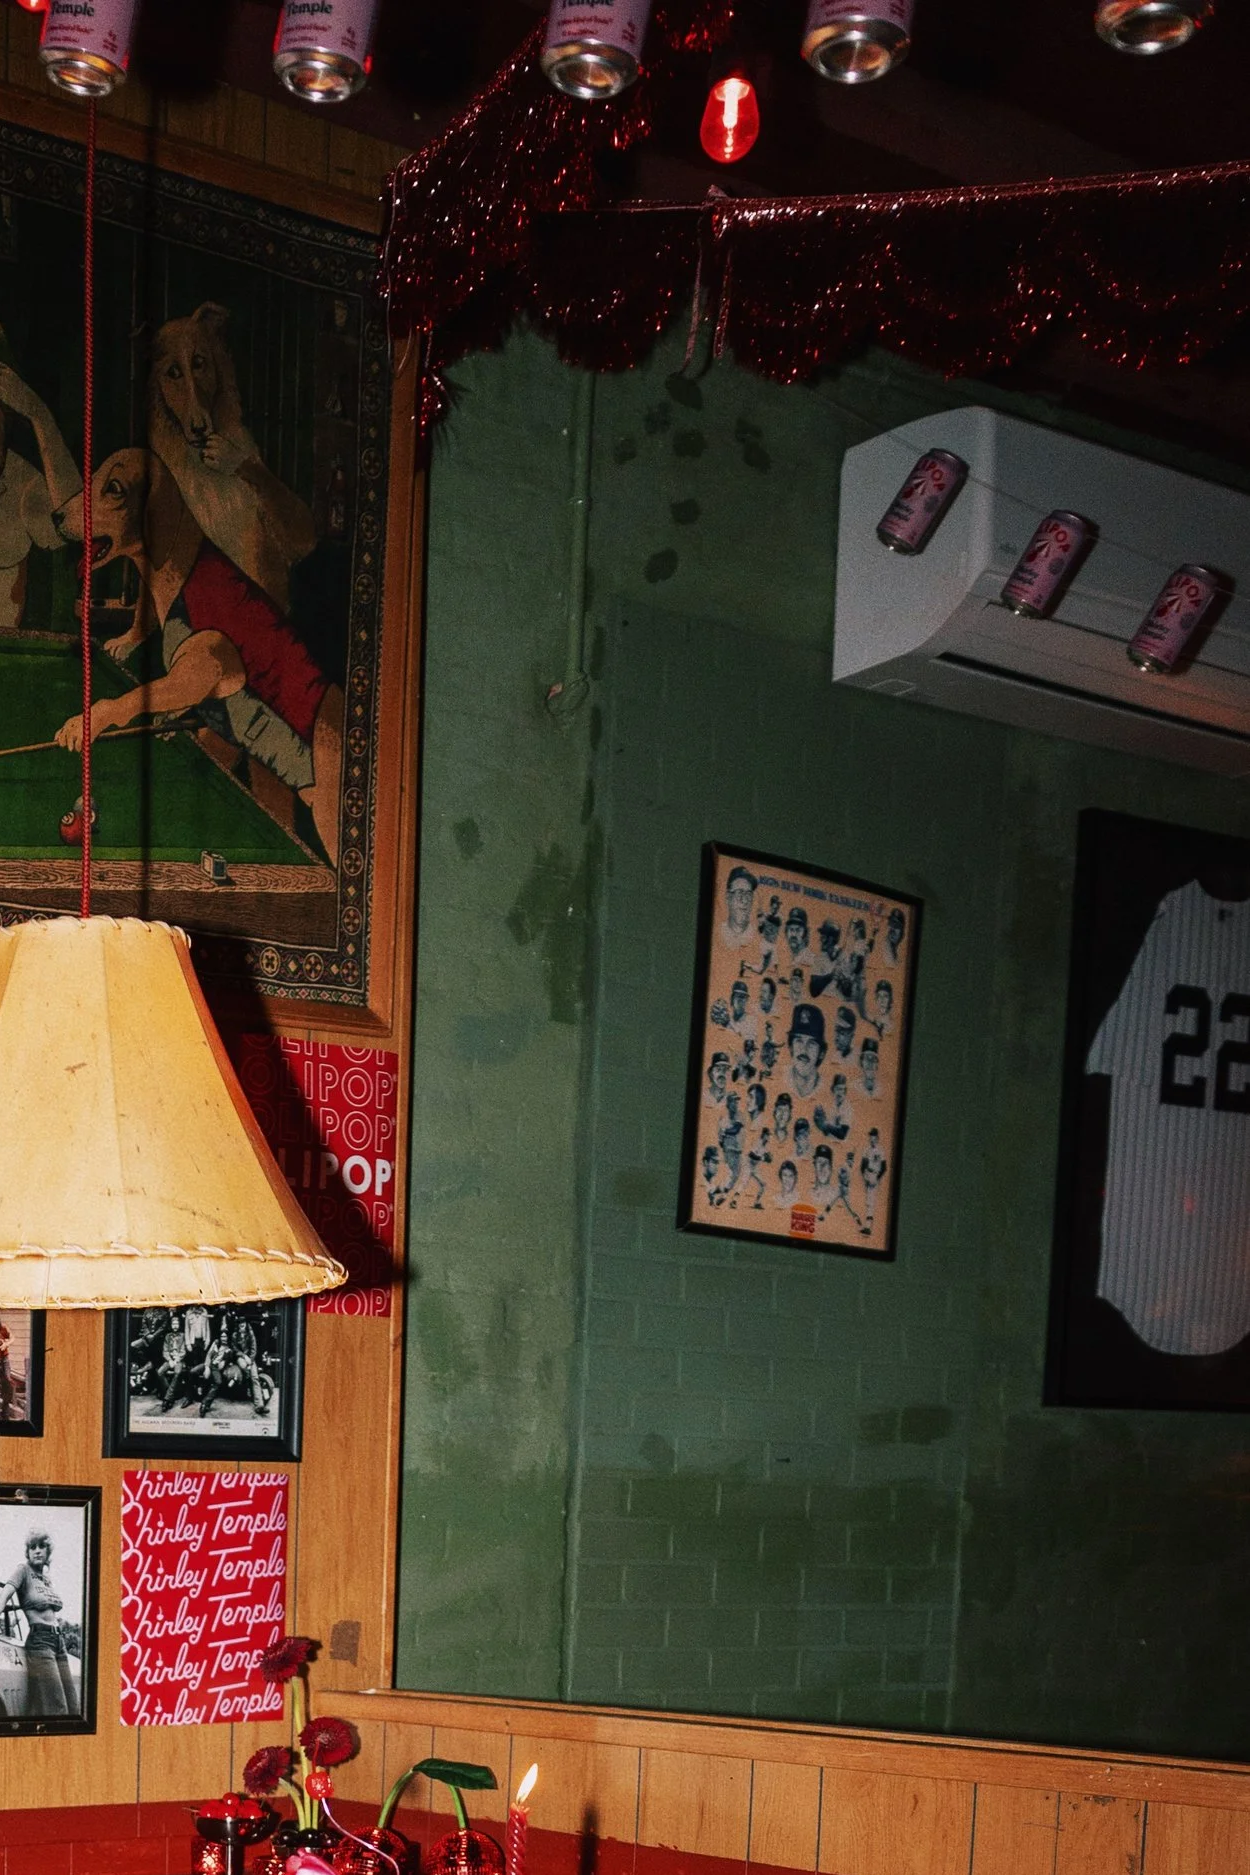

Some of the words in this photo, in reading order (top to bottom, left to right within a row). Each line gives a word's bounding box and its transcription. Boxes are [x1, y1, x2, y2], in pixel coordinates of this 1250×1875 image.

[1160, 984, 1250, 1113] 22
[278, 1147, 391, 1197] LIPOP
[207, 1491, 287, 1544] Temple
[208, 1536, 286, 1589] Temple
[208, 1581, 285, 1636] Temple
[207, 1681, 283, 1723] Temple
